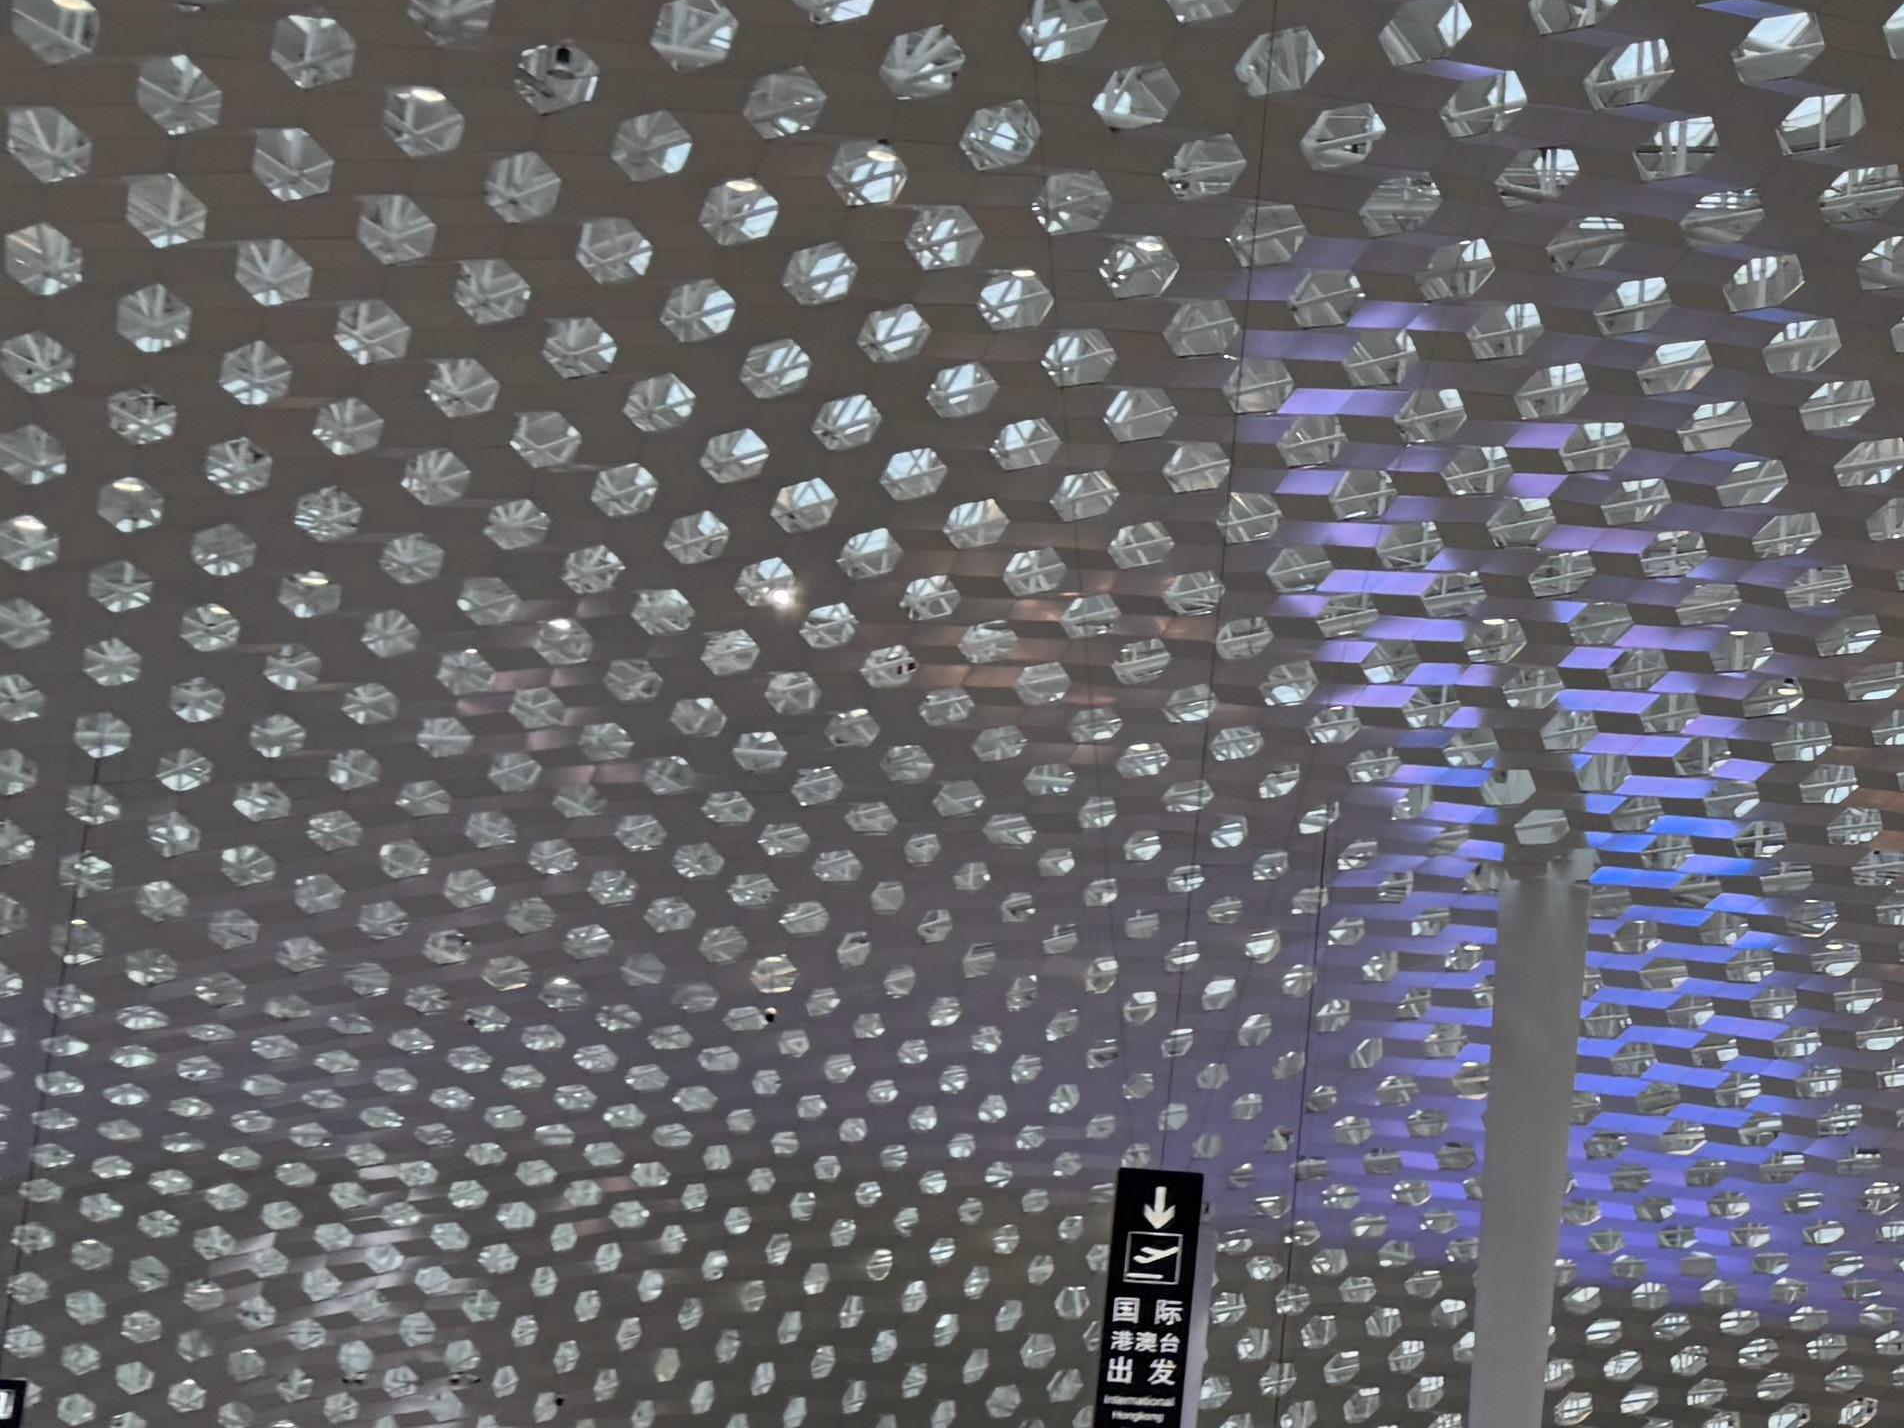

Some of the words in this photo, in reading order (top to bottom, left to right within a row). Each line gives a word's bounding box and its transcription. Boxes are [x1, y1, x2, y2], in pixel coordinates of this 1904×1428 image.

[1112, 1296, 1184, 1325] 国际
[1110, 1330, 1181, 1354] 港澳台
[1106, 1355, 1177, 1386] 出发
